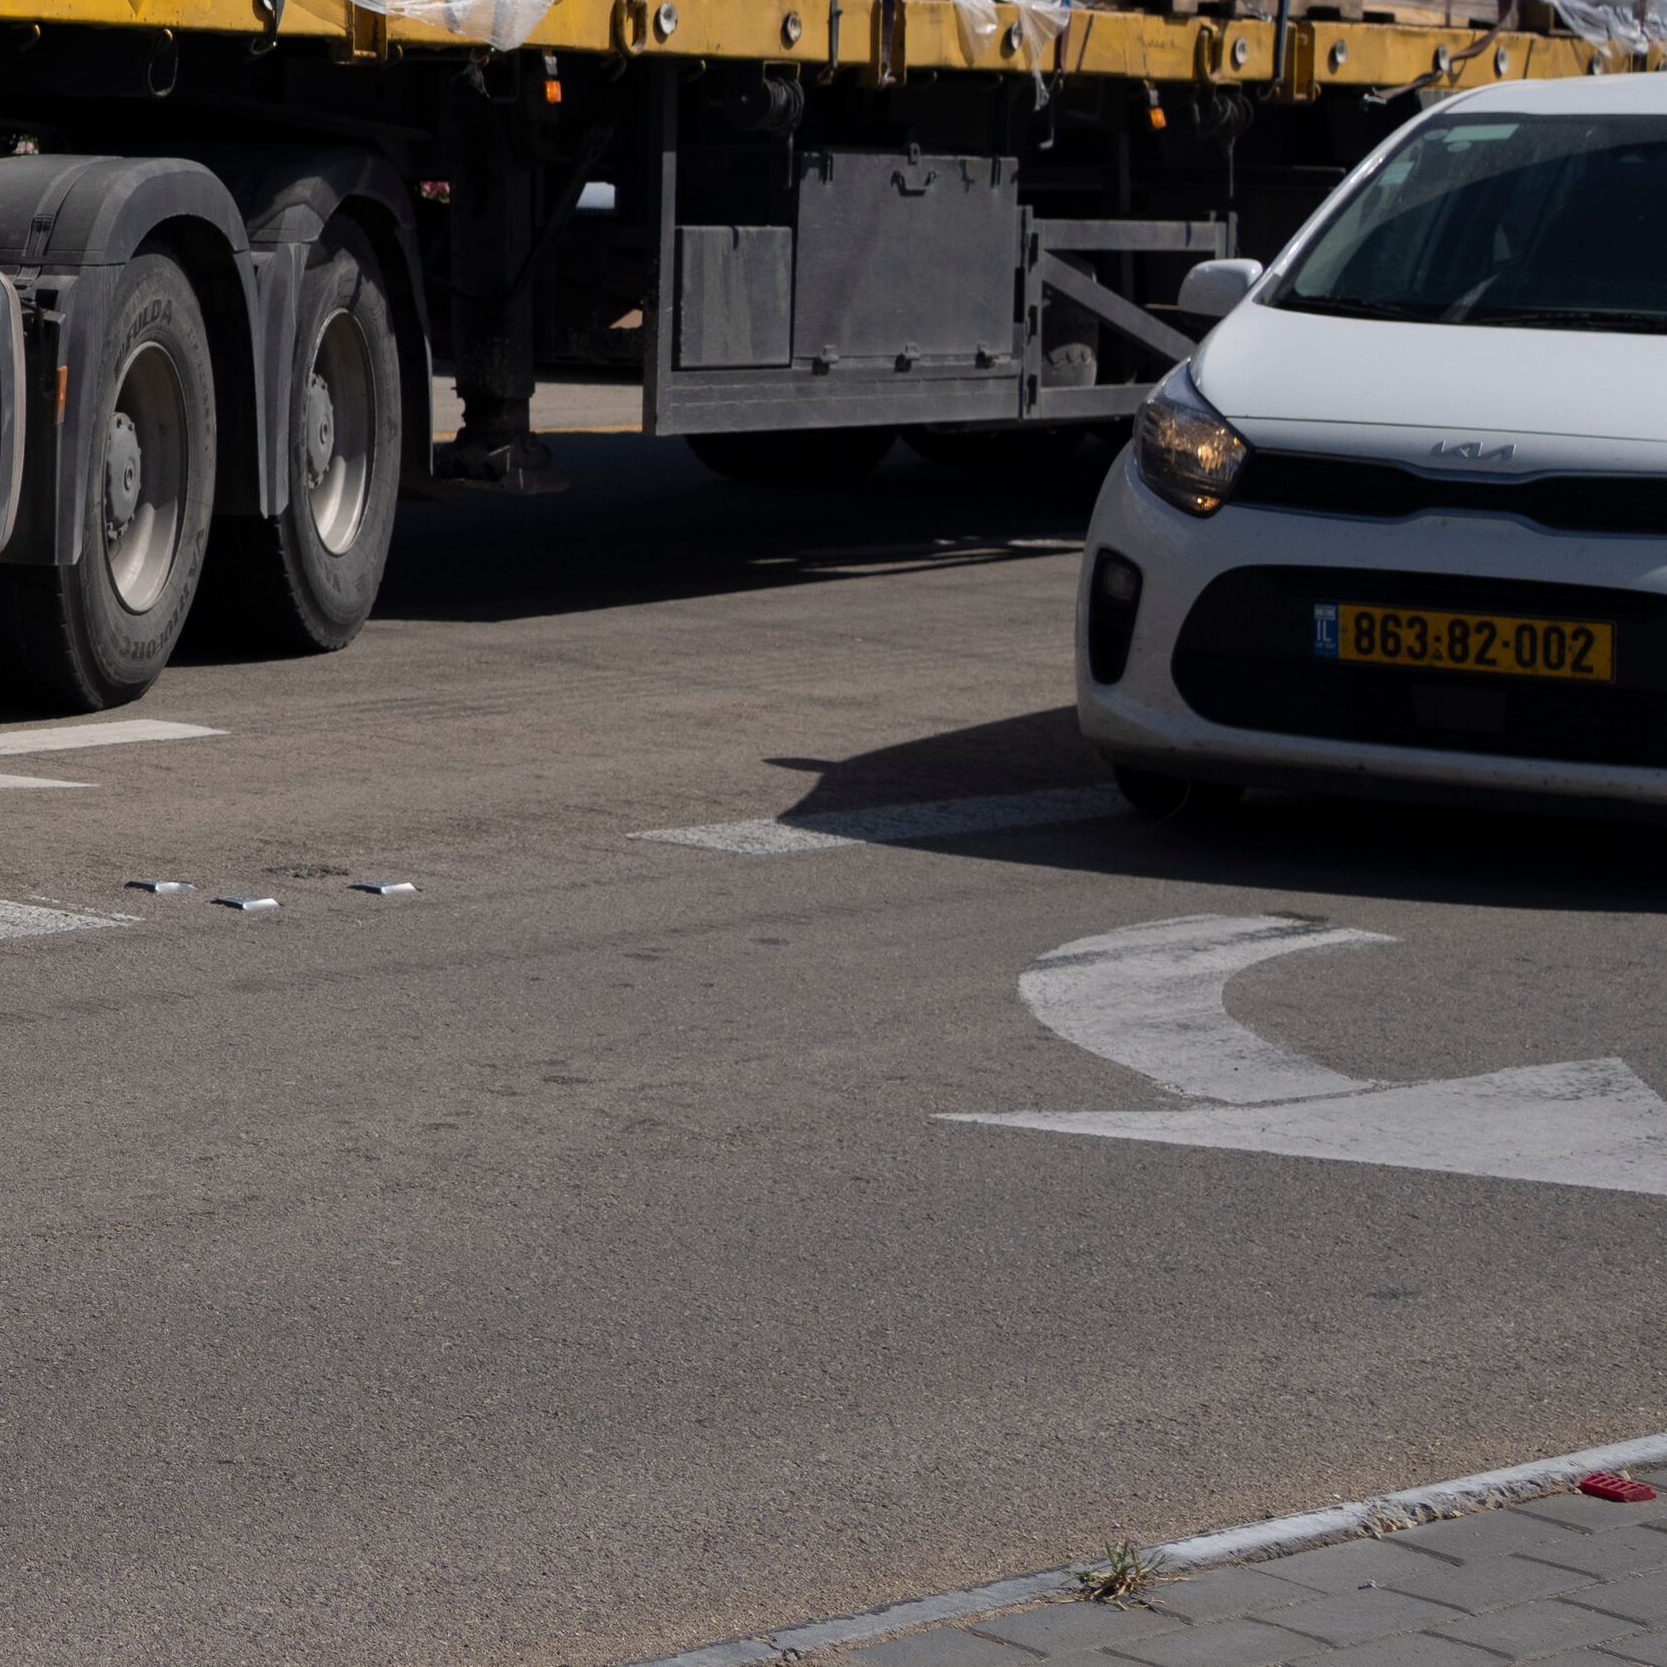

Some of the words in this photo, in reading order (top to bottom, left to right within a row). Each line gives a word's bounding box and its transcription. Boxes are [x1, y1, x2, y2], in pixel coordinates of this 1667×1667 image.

[126, 299, 173, 345] FULDA
[1430, 439, 1517, 461] KIA
[1316, 620, 1332, 642] IL
